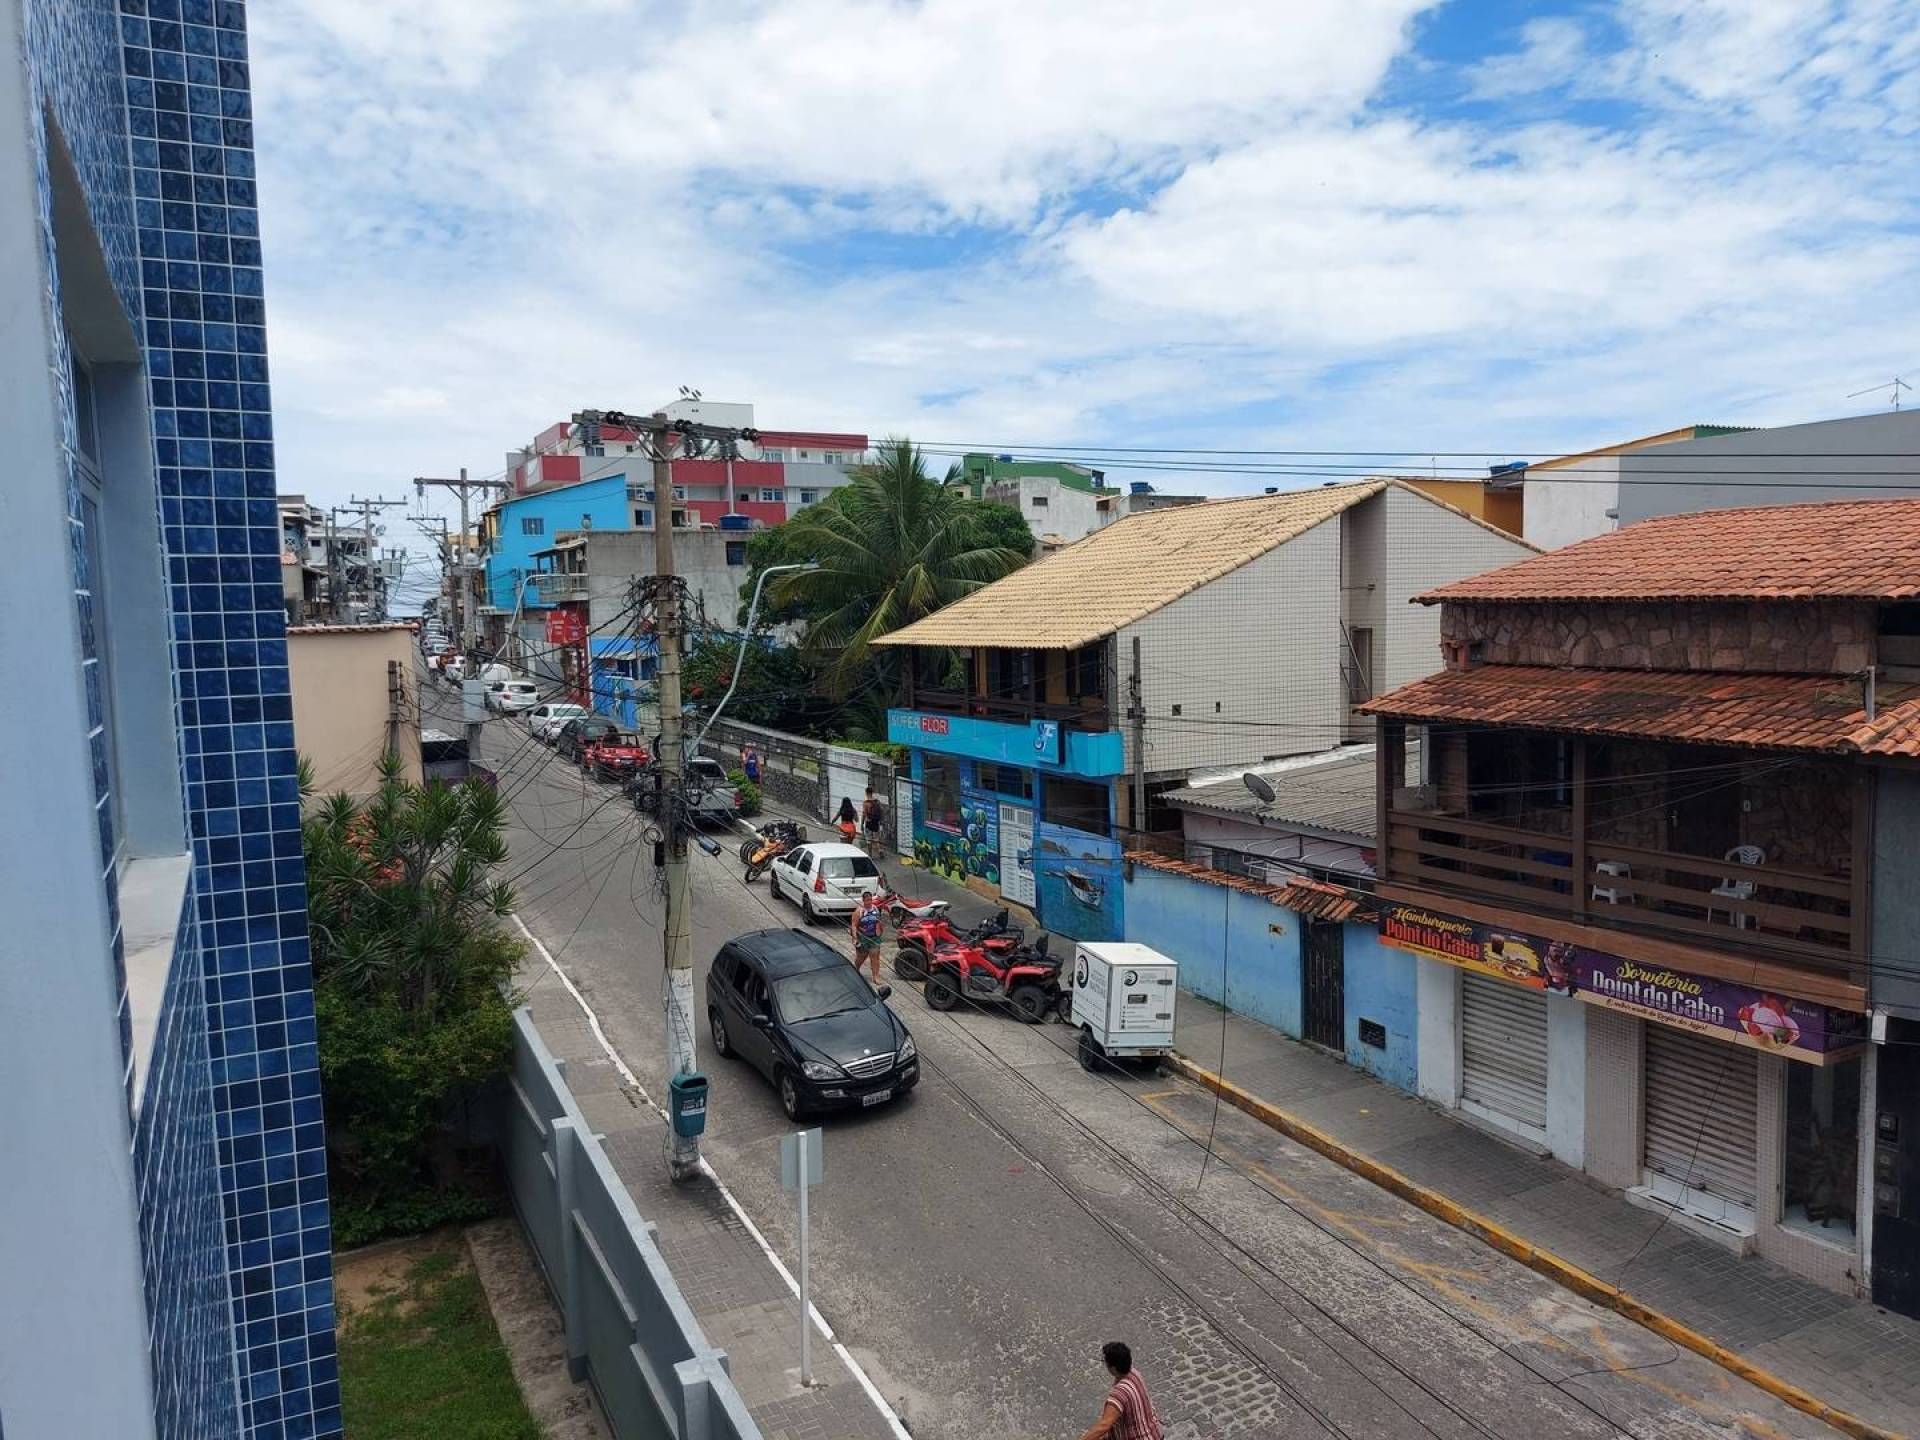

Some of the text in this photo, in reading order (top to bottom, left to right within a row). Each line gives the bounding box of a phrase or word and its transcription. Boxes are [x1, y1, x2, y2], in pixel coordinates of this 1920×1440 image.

[922, 717, 947, 733] FLOR
[1386, 918, 1421, 943] Point
[1422, 928, 1441, 949] do
[1442, 932, 1480, 961] Cabo
[1592, 970, 1640, 1004] Point
[1643, 984, 1668, 1010] do
[1671, 991, 1725, 1025] Cabo
[1616, 962, 1702, 995] Sorveteria
